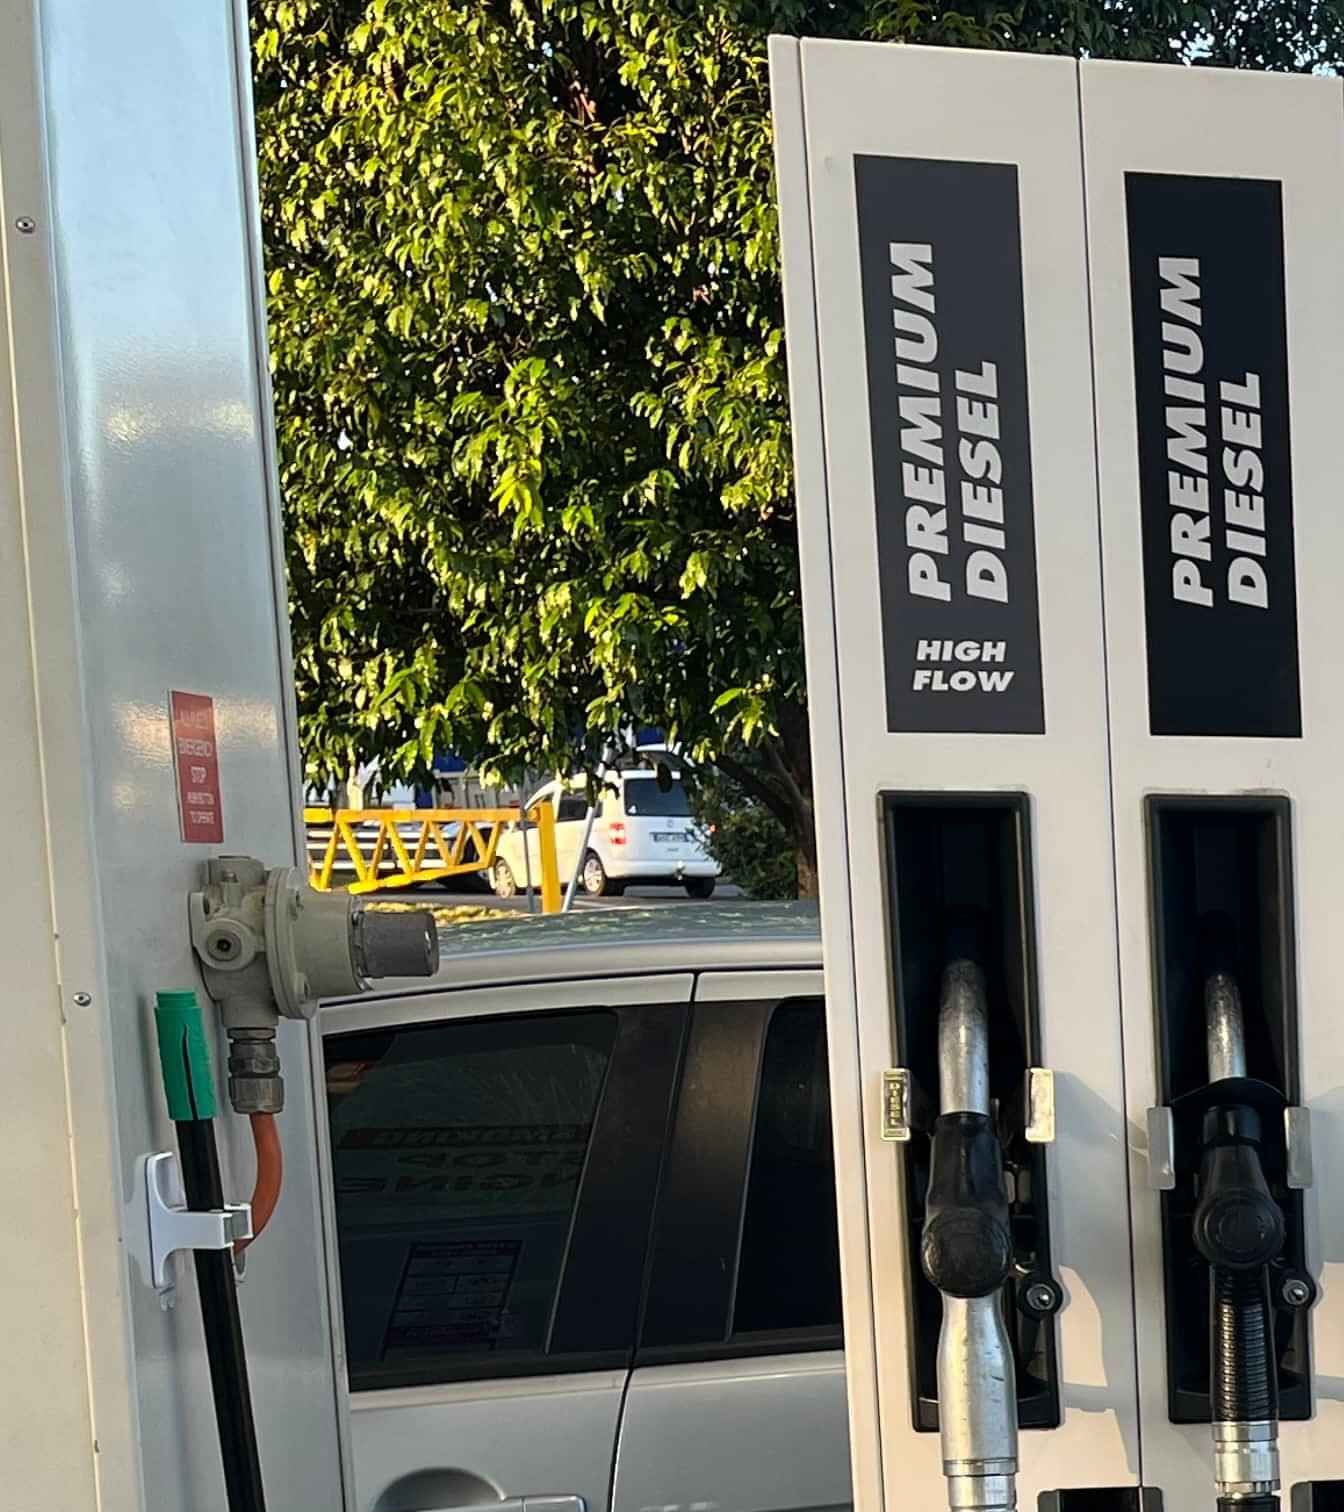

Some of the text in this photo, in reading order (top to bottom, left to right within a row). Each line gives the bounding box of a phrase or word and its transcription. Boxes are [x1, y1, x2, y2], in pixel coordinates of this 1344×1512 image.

[889, 242, 951, 601] PREMIUM
[956, 361, 1008, 604] DIESEL
[1158, 256, 1214, 608] PREMIUM
[1219, 371, 1269, 609] DIESEL
[912, 670, 1014, 692] FLOW
[916, 640, 1007, 662] HIGH
